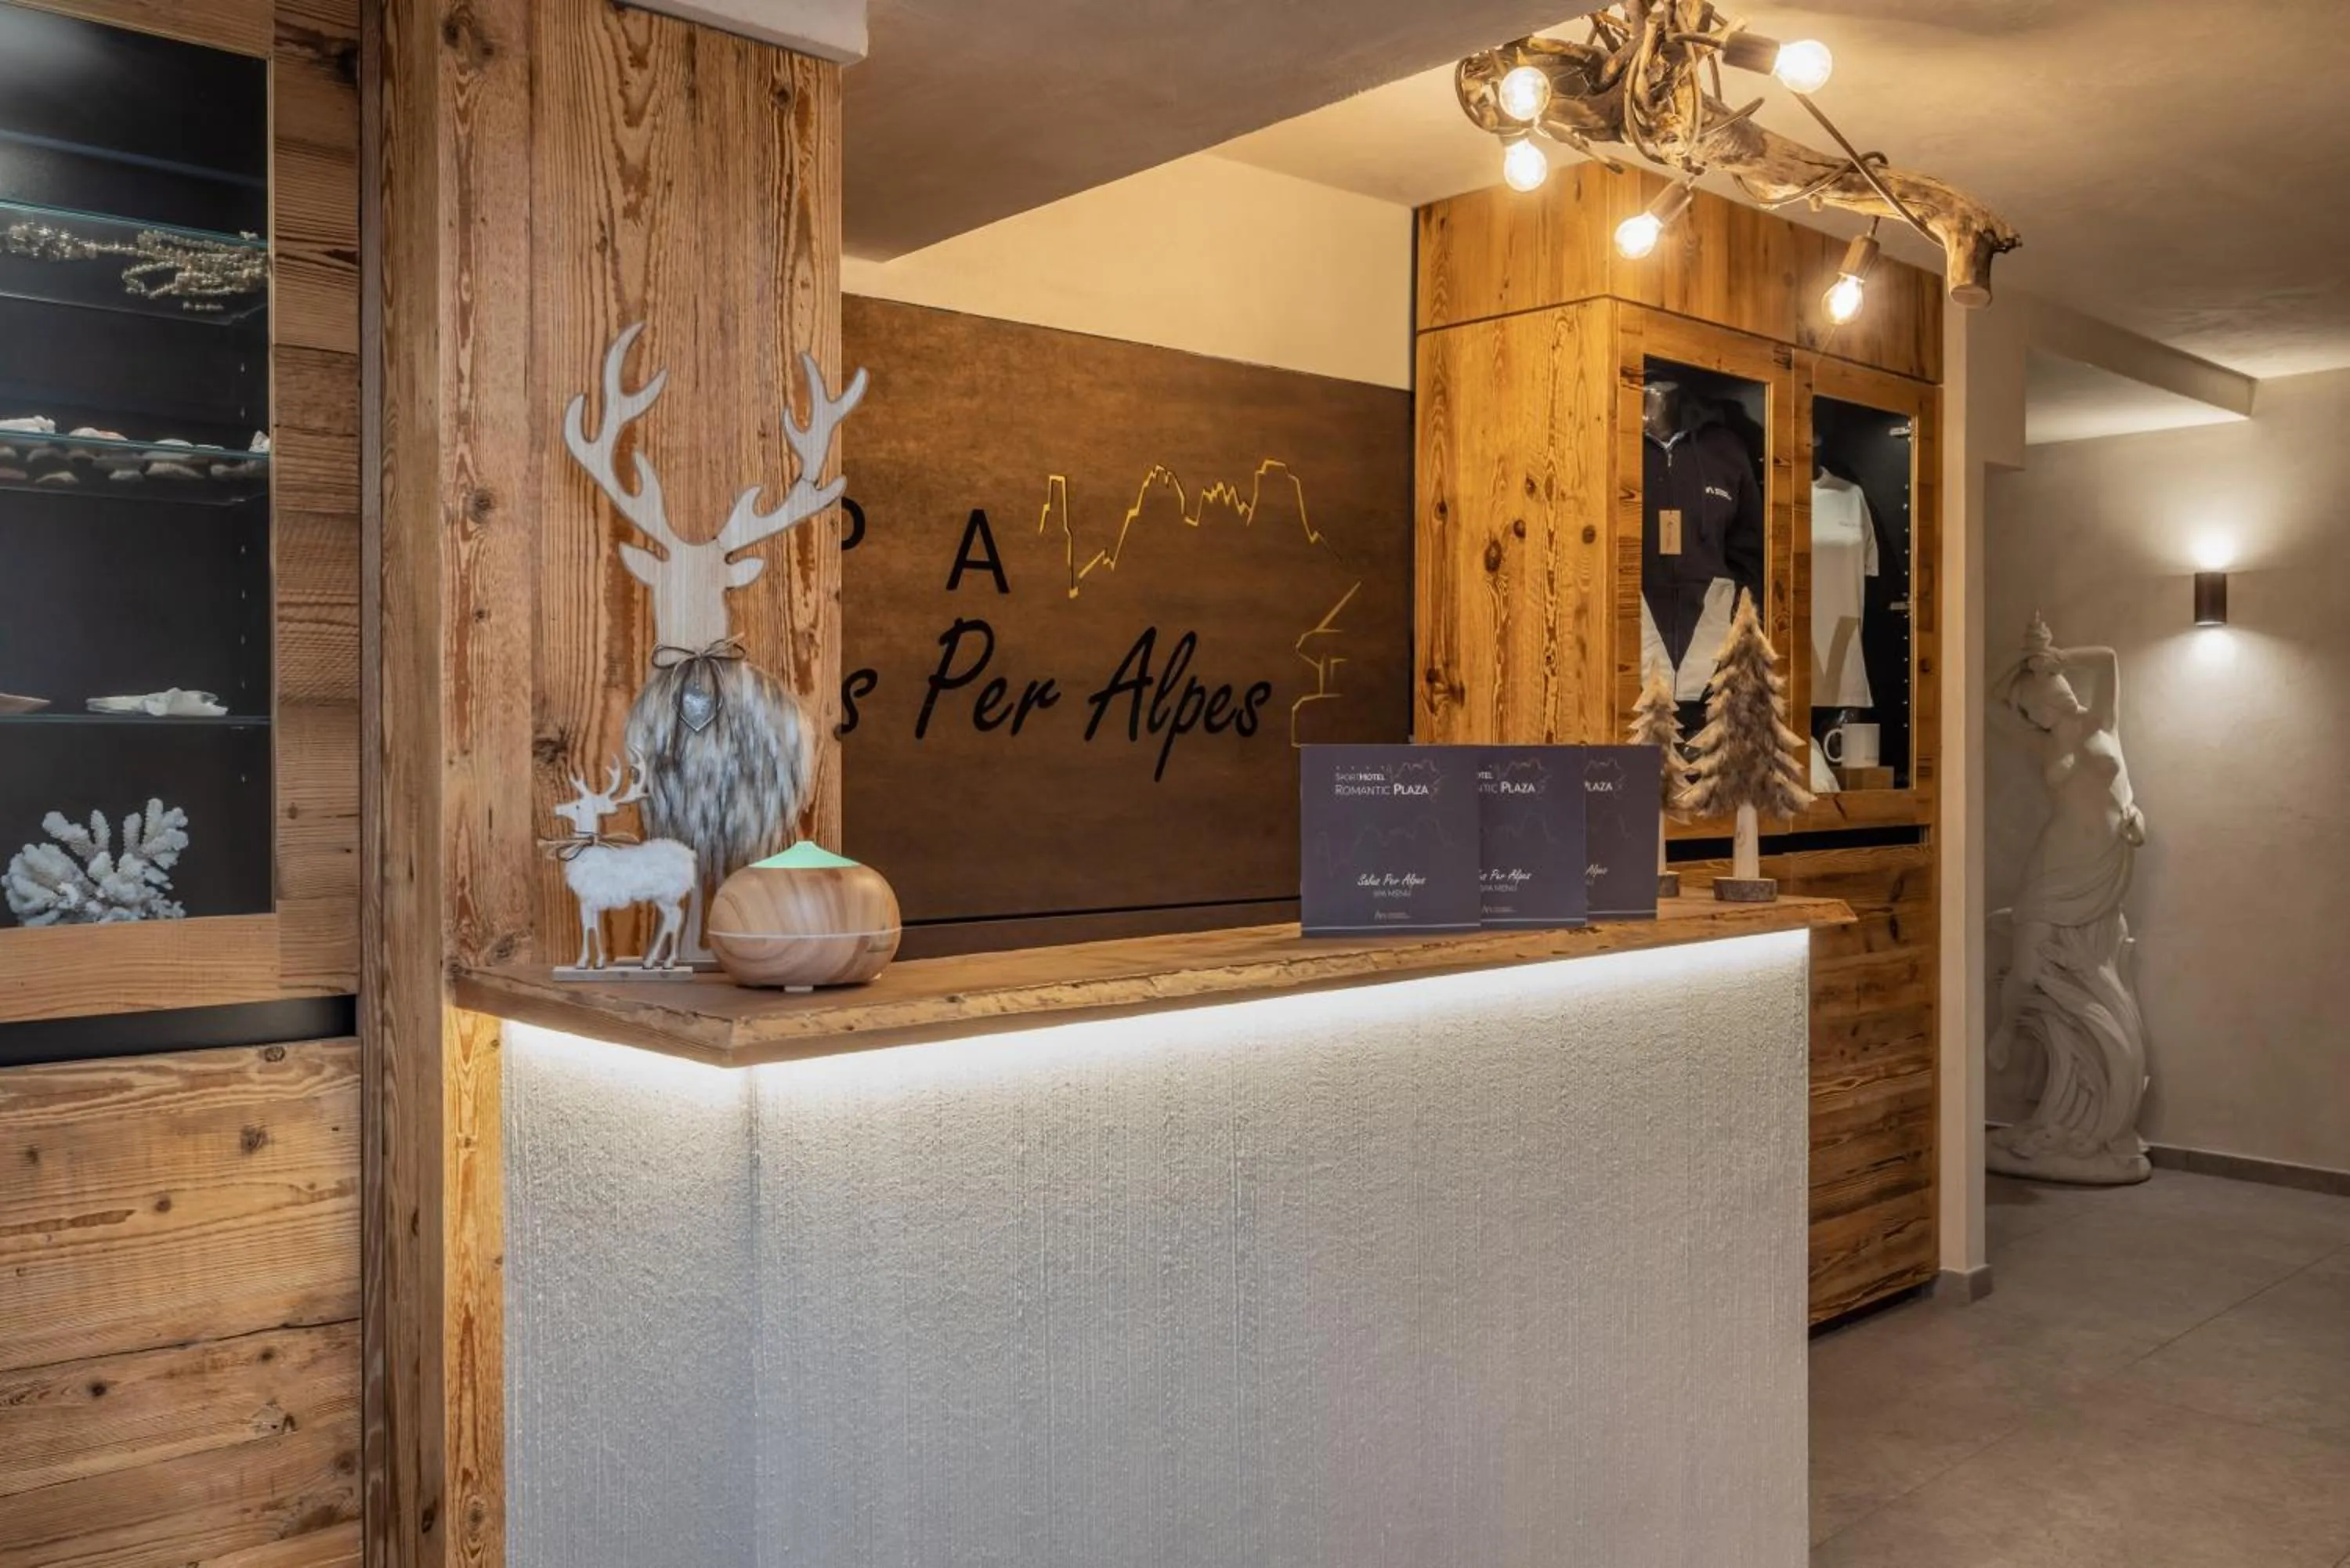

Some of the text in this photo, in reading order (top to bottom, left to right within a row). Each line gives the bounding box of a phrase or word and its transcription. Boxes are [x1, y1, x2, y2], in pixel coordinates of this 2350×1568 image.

[914, 617, 1060, 739] Per
[1084, 627, 1271, 782] Alpes
[1335, 783, 1429, 796] ROMANTIC PLAZA
[1500, 781, 1536, 793] PLAZA
